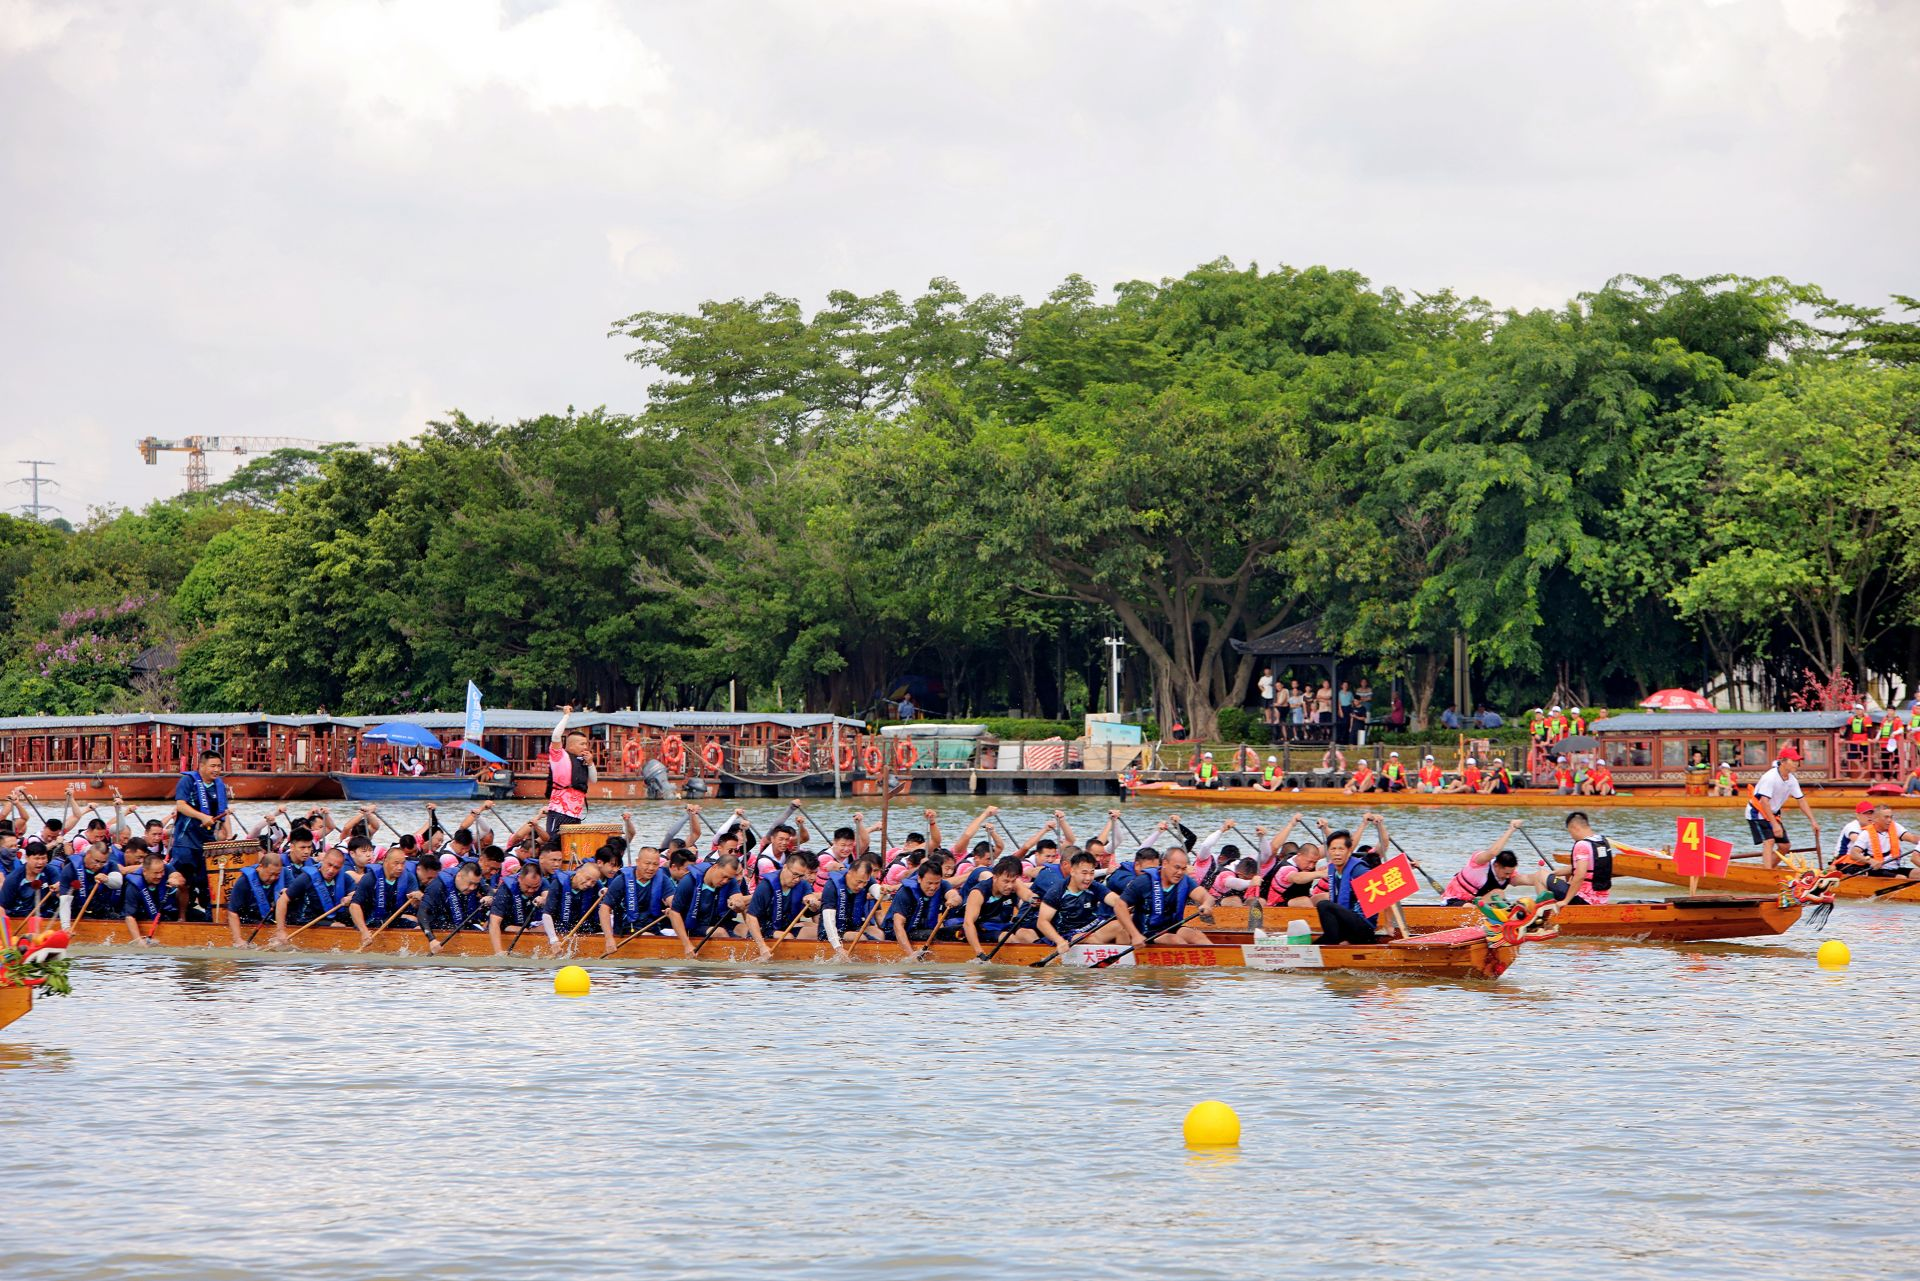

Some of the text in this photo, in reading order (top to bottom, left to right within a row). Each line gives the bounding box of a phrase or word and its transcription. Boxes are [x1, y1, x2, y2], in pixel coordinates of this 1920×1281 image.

[1682, 822, 1700, 851] 4
[1153, 880, 1163, 915] LIFEJACKET
[1364, 866, 1406, 903] 大盛
